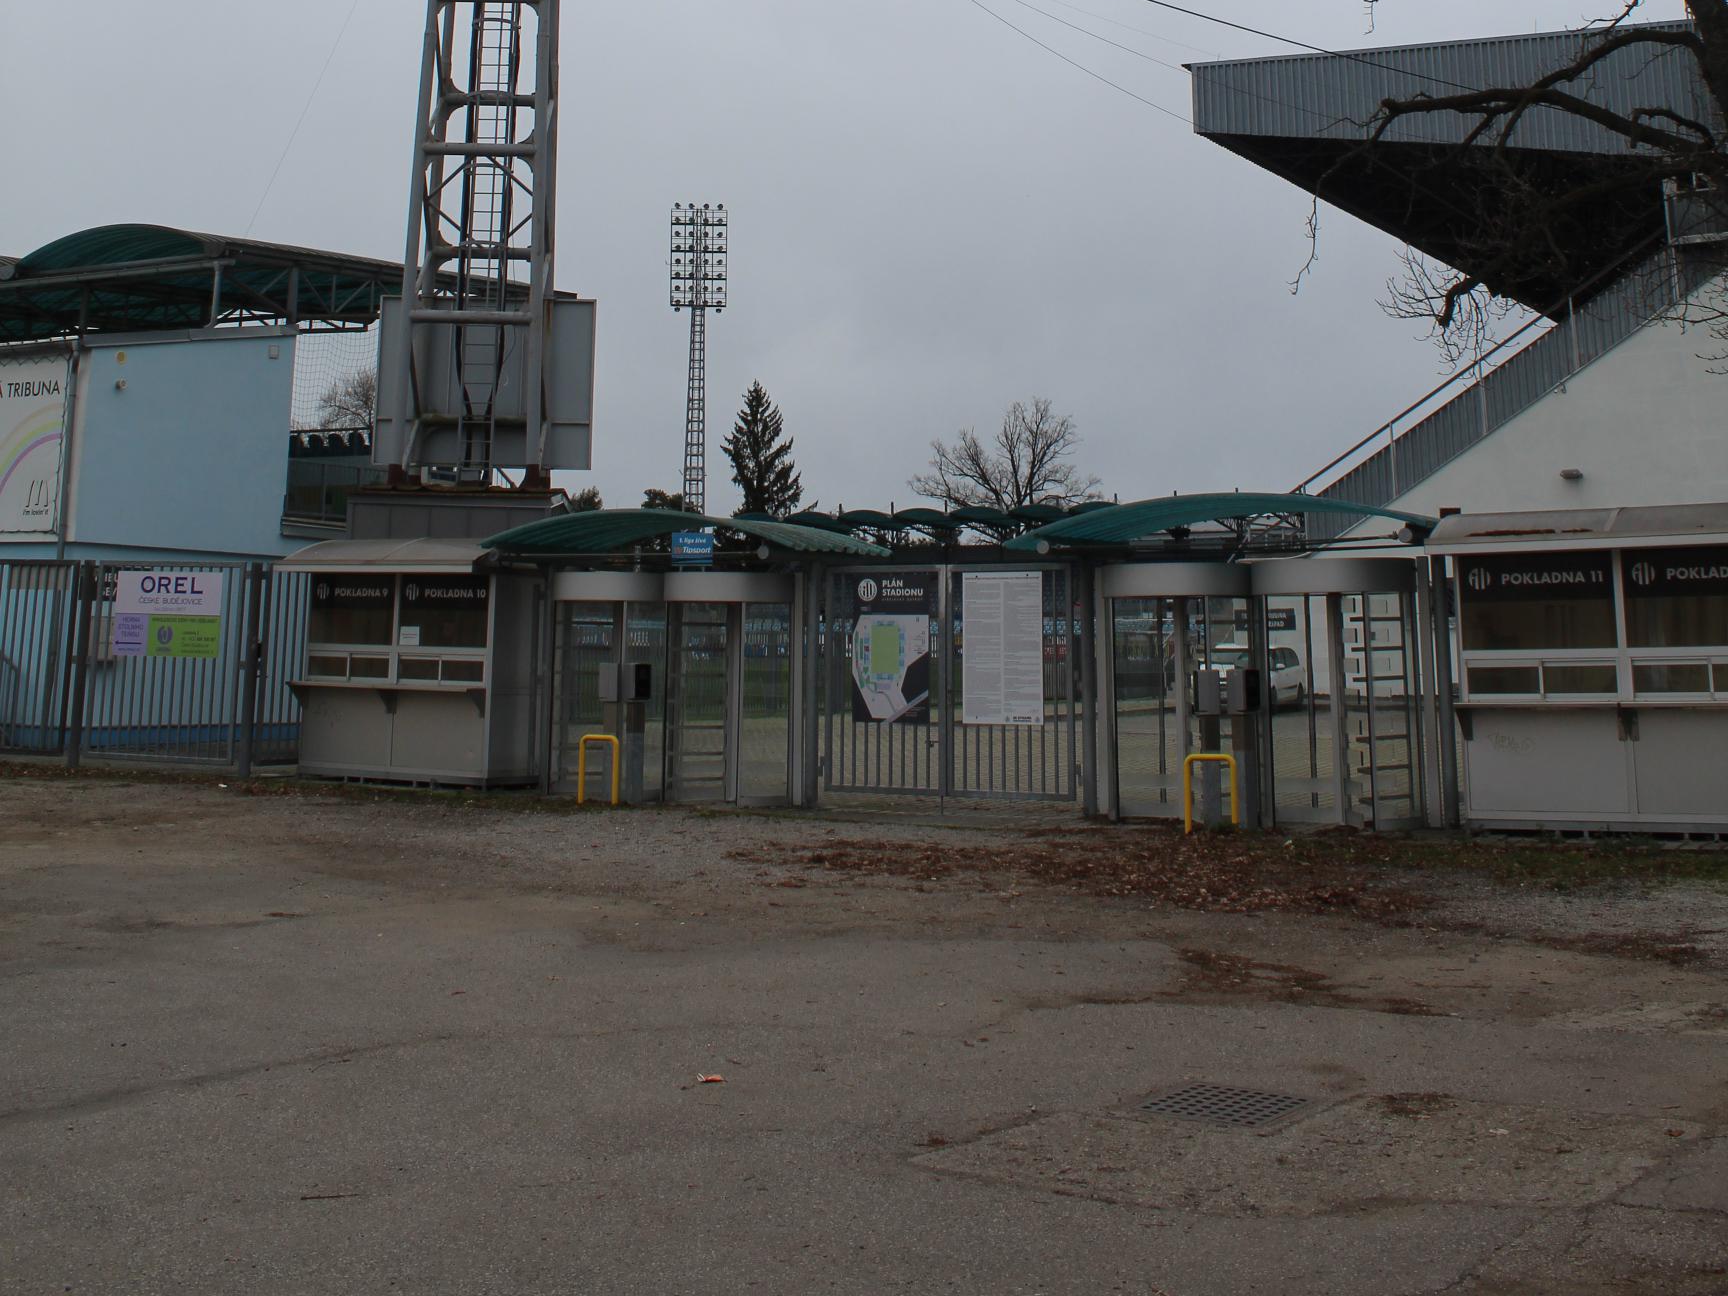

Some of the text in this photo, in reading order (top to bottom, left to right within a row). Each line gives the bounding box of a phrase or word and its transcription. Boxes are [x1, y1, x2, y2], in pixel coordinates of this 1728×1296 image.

[8, 380, 60, 398] TRIBUNA
[682, 546, 711, 554] Tipsport
[1501, 570, 1604, 585] POKLADNA 11
[1666, 566, 1728, 580] POKLAD
[141, 576, 203, 595] OREL
[882, 577, 903, 587] PLÁN
[334, 588, 389, 598] POKLADNA 9
[424, 588, 487, 599] POKLADNA 10
[882, 588, 924, 597] STADIONU
